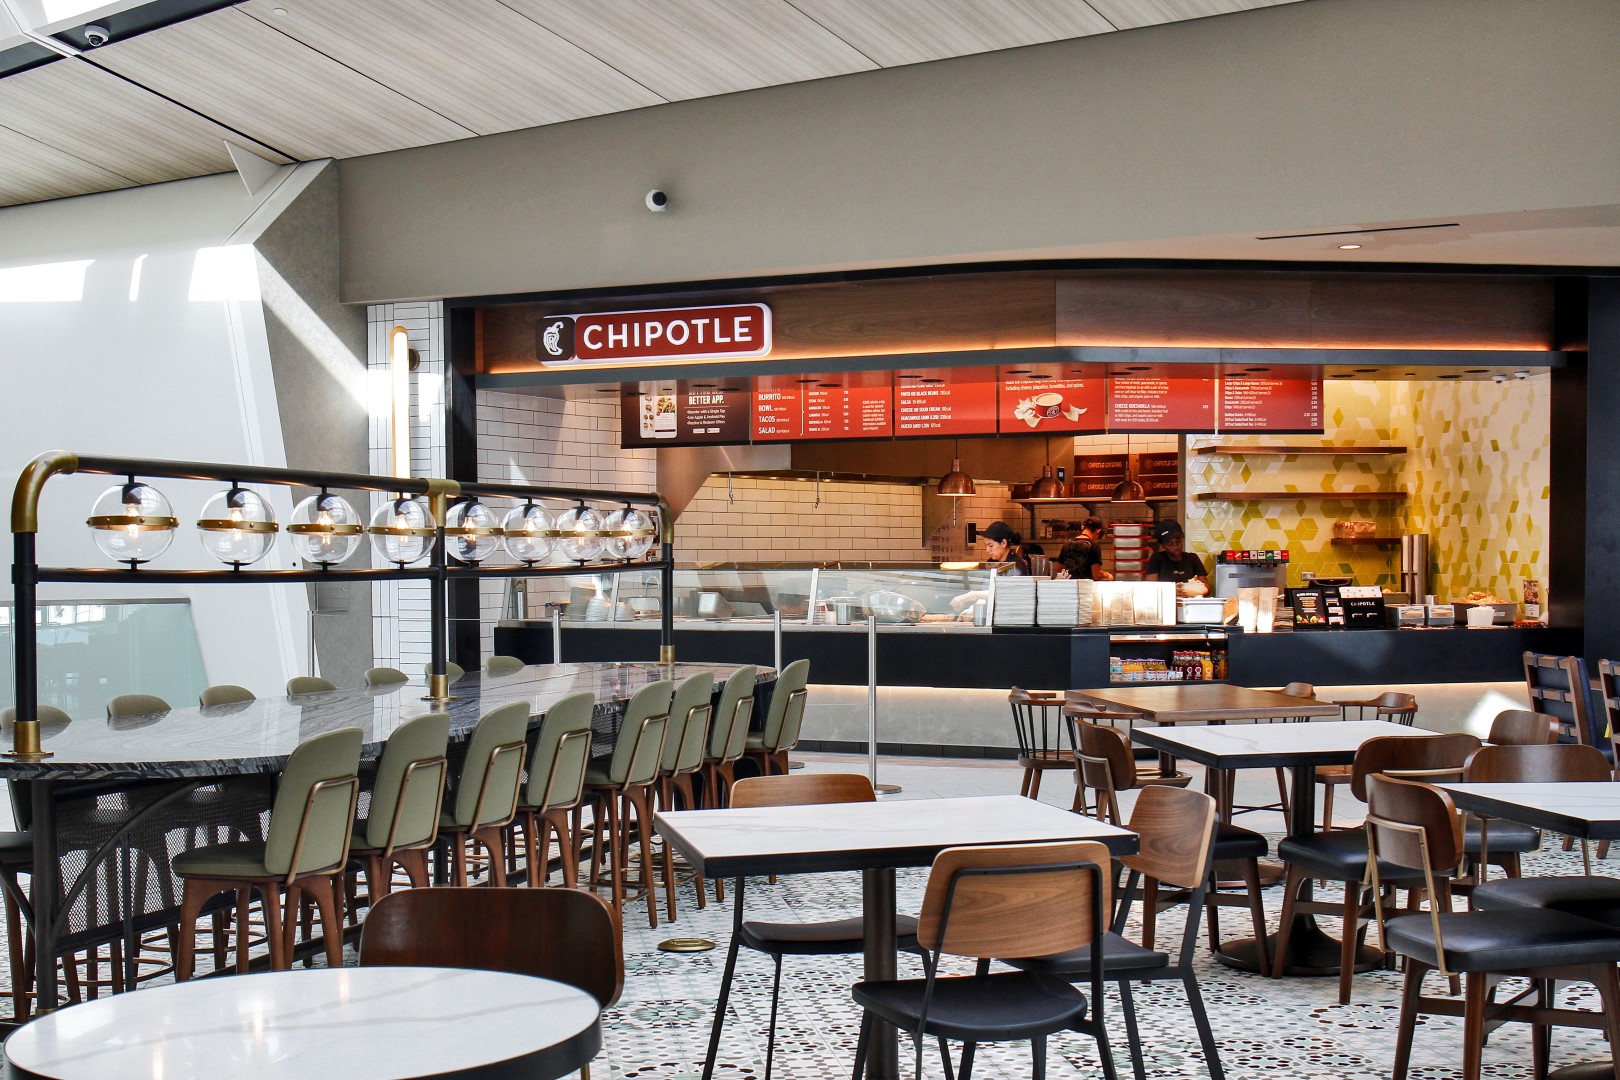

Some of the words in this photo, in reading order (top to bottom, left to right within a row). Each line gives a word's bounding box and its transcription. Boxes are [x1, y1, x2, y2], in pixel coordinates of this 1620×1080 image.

[583, 315, 753, 350] CHIPOTLE
[688, 395, 711, 405] BETTER
[711, 394, 724, 404] APP.
